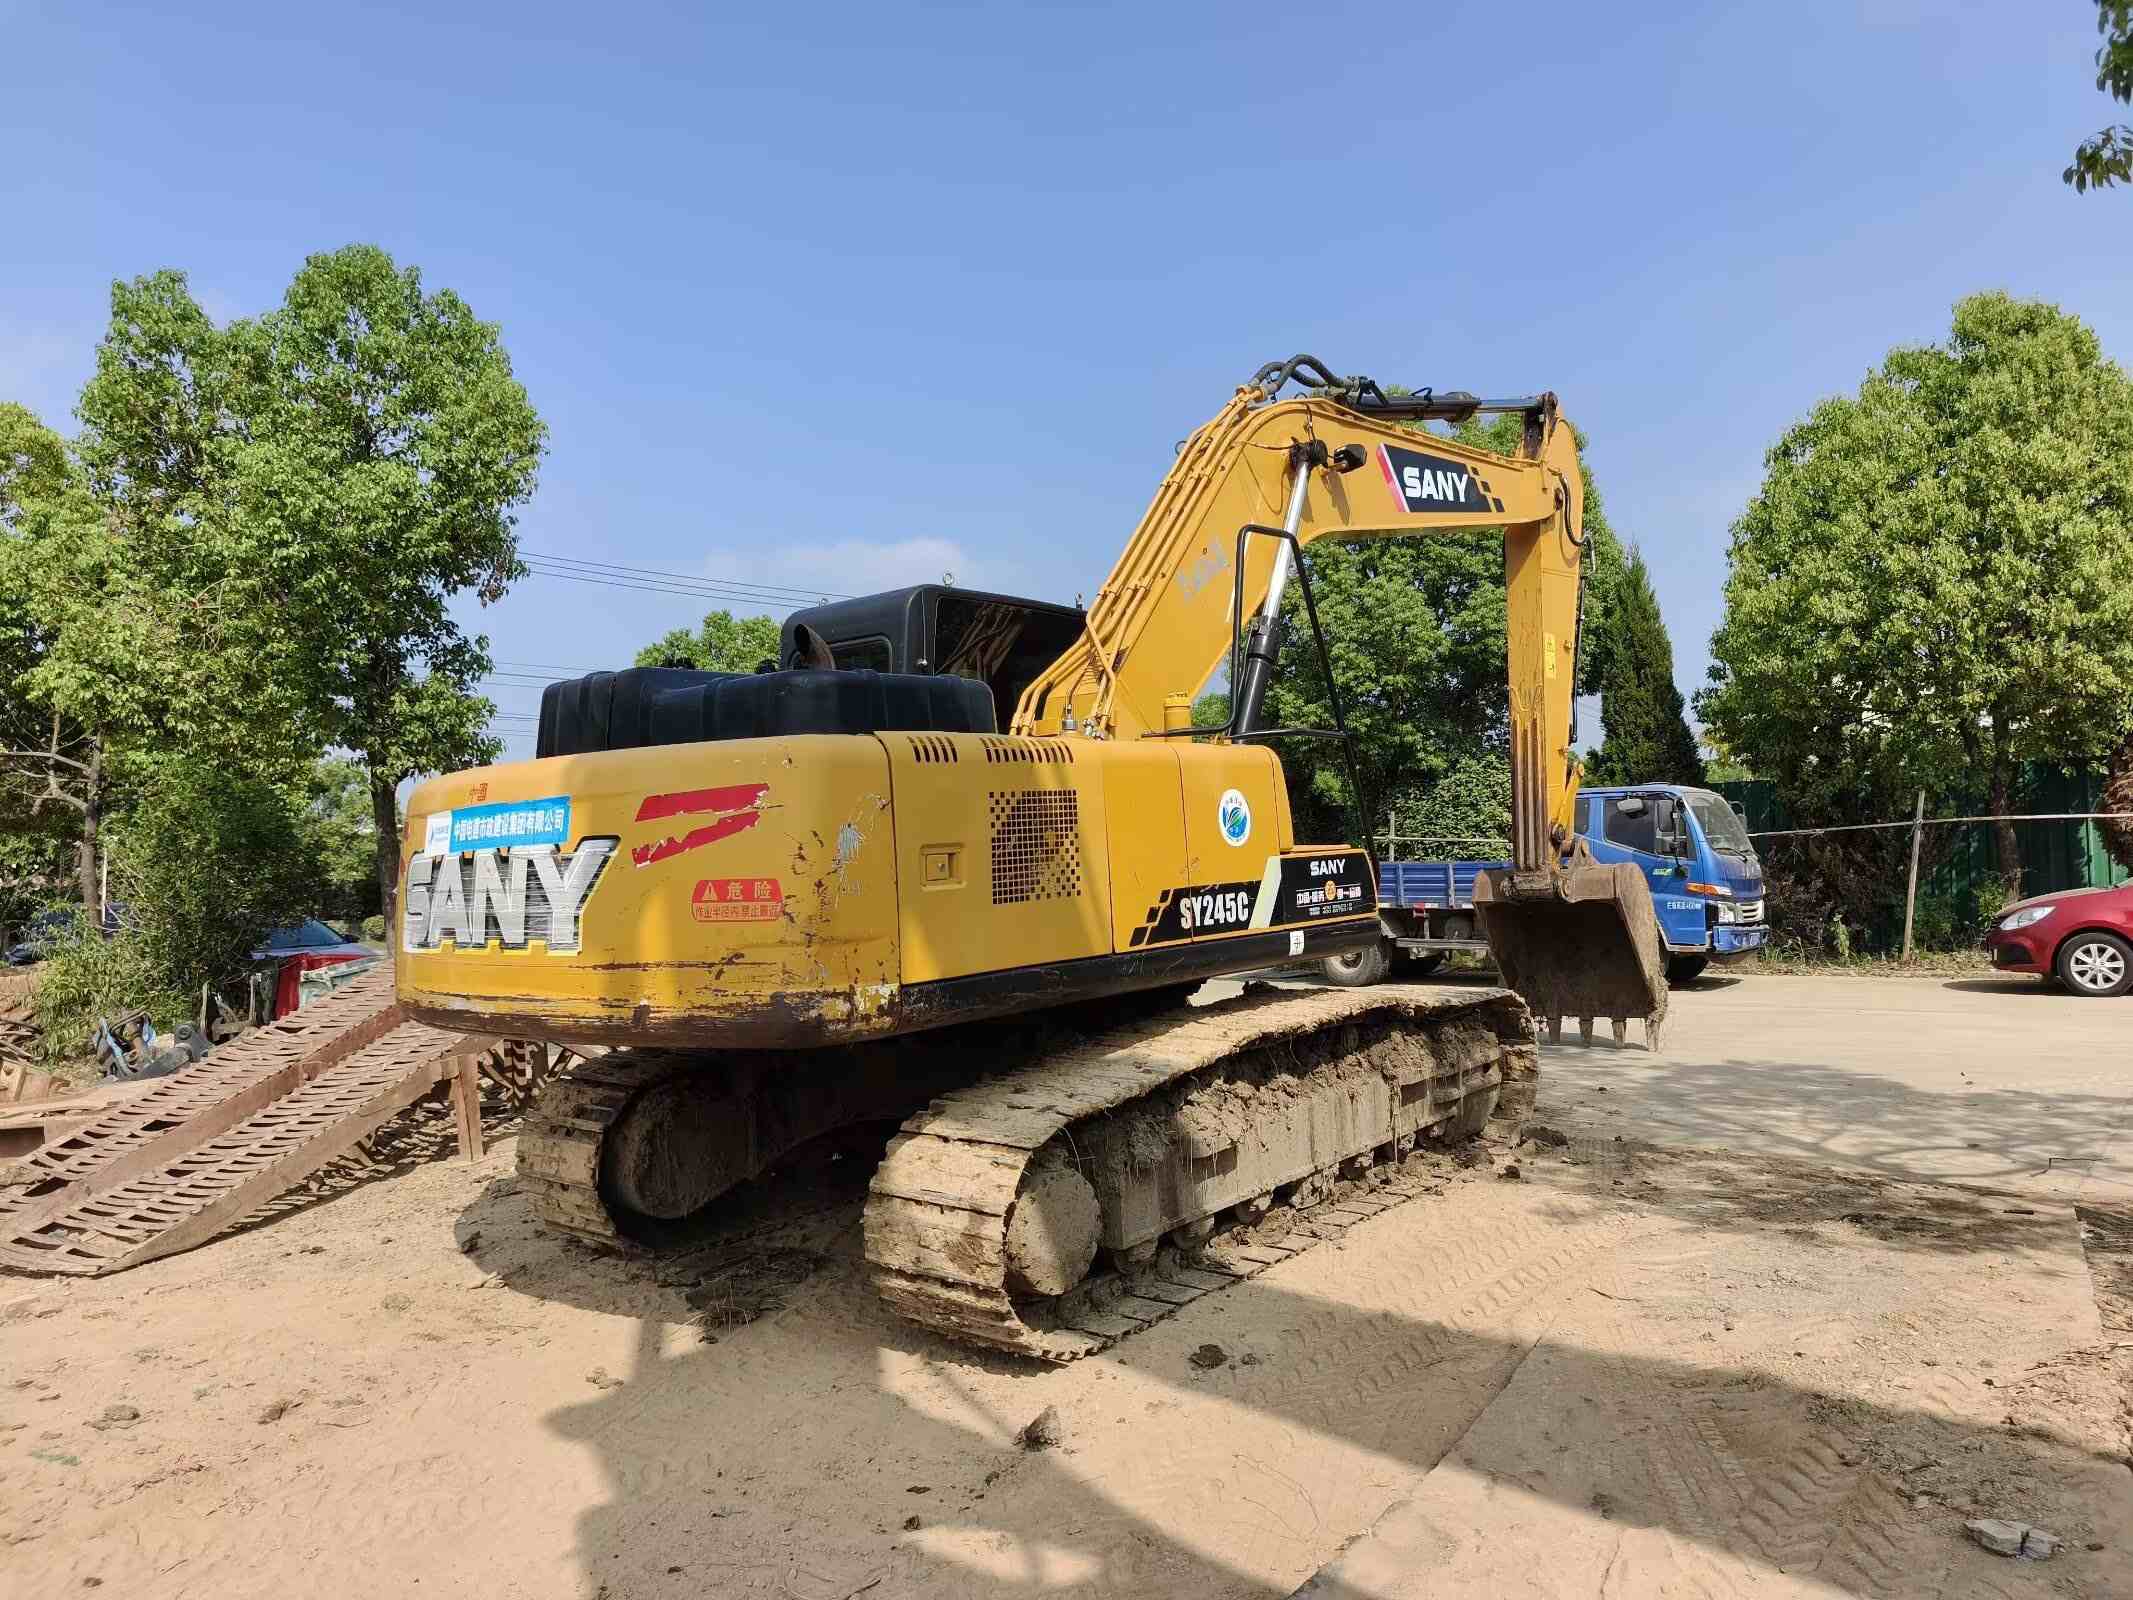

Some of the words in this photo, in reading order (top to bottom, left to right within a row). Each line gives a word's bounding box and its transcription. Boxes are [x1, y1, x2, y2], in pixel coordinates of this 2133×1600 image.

[1402, 466, 1469, 502] SANY
[1310, 858, 1346, 876] SANY
[404, 838, 618, 948] SANY
[727, 880, 772, 900] 危险
[1180, 891, 1249, 929] SY245C
